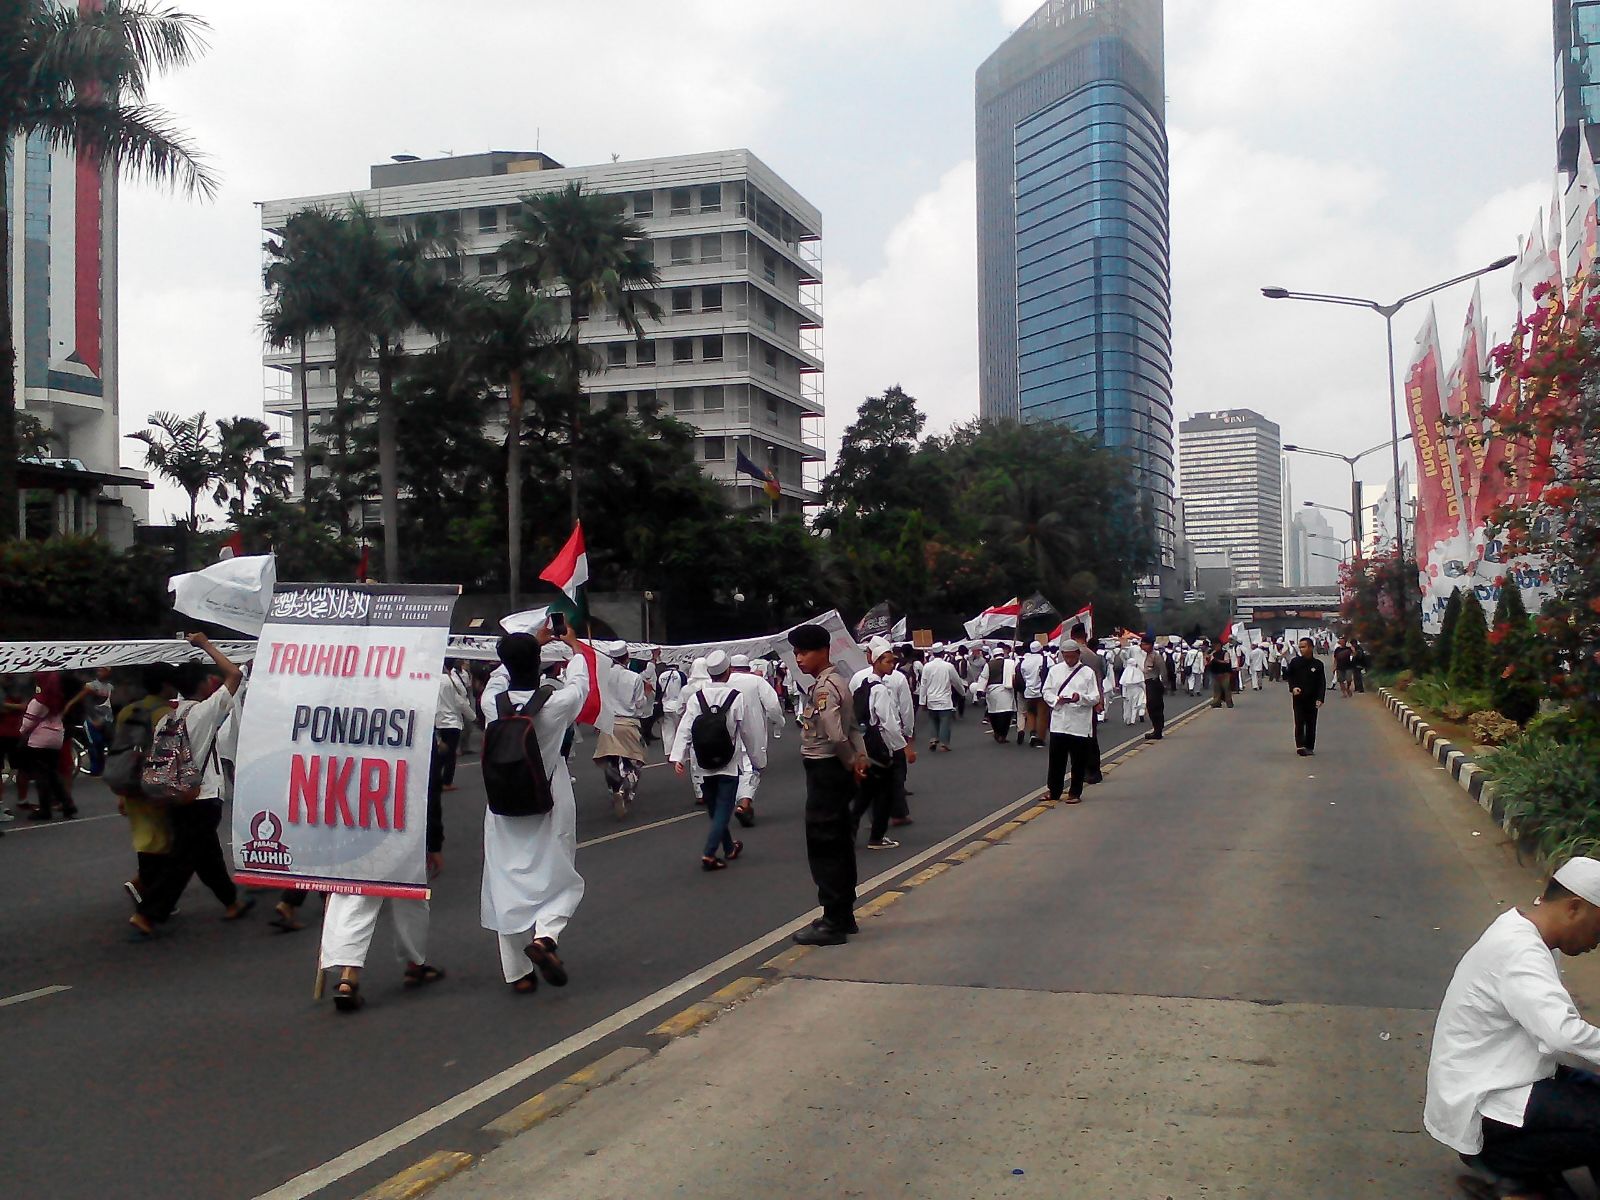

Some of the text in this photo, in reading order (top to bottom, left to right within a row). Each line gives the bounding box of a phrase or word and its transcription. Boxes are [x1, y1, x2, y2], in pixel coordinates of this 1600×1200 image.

[1230, 415, 1245, 423] BNI
[268, 642, 360, 677] TAUHID
[363, 645, 406, 679] ITU
[291, 705, 416, 748] PONDASI
[287, 754, 408, 831] NKRI
[242, 850, 293, 866] TAUHID
[253, 841, 278, 850] PARADE
